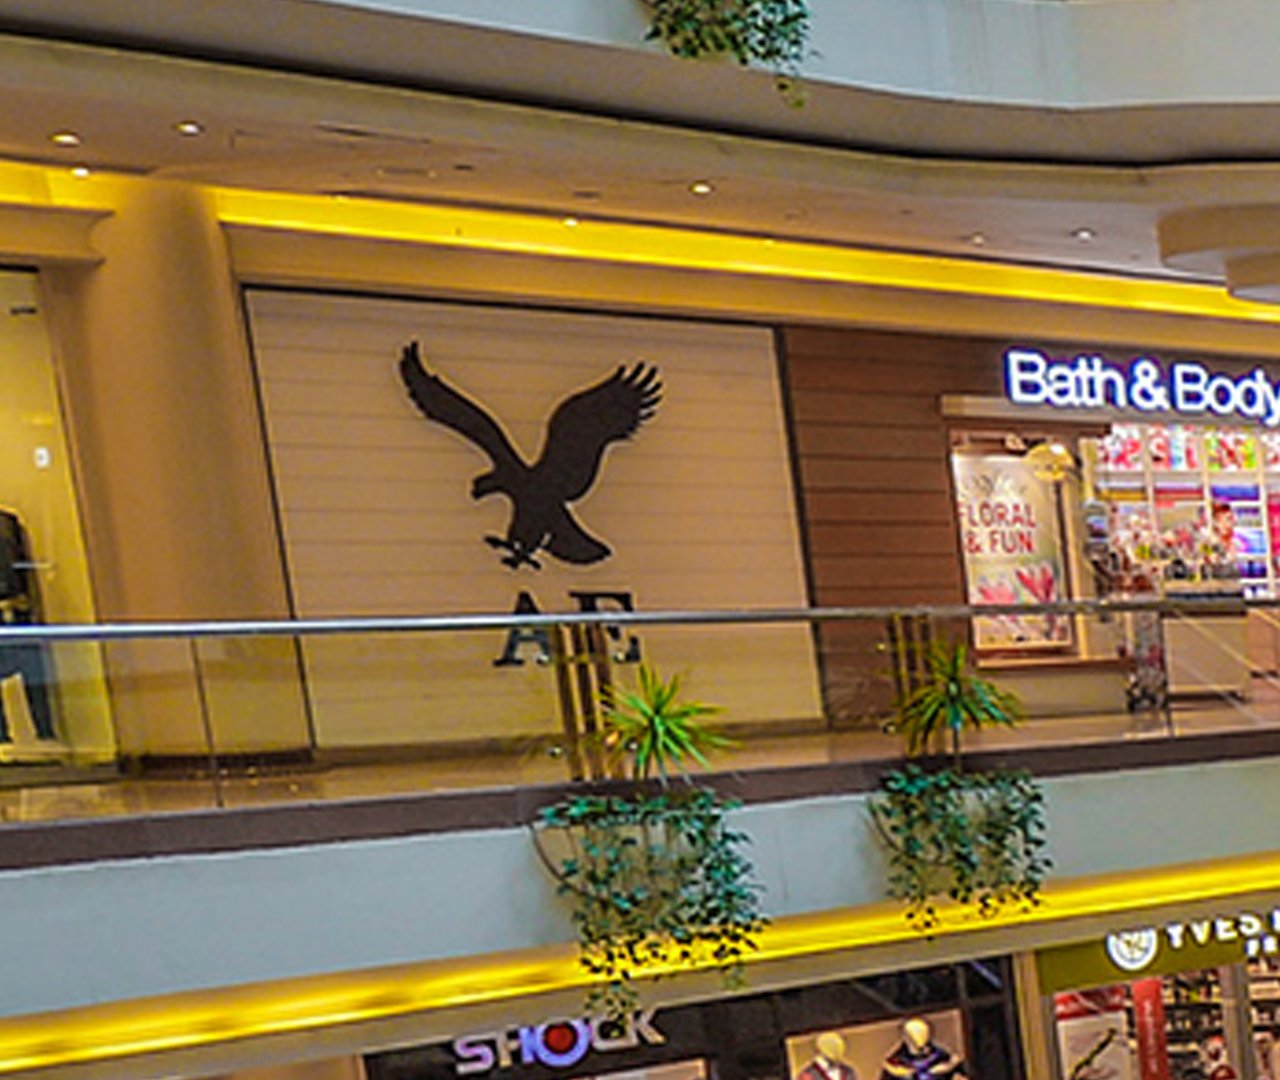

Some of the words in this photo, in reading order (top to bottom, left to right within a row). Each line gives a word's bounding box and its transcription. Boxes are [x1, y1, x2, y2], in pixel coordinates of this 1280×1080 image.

[1006, 350, 1127, 407] Bath
[1129, 358, 1170, 411] &
[957, 502, 1036, 529] FLORAL
[989, 529, 1036, 554] FUN
[1165, 913, 1261, 949] YVES
[453, 1009, 666, 1076] SHOCK
